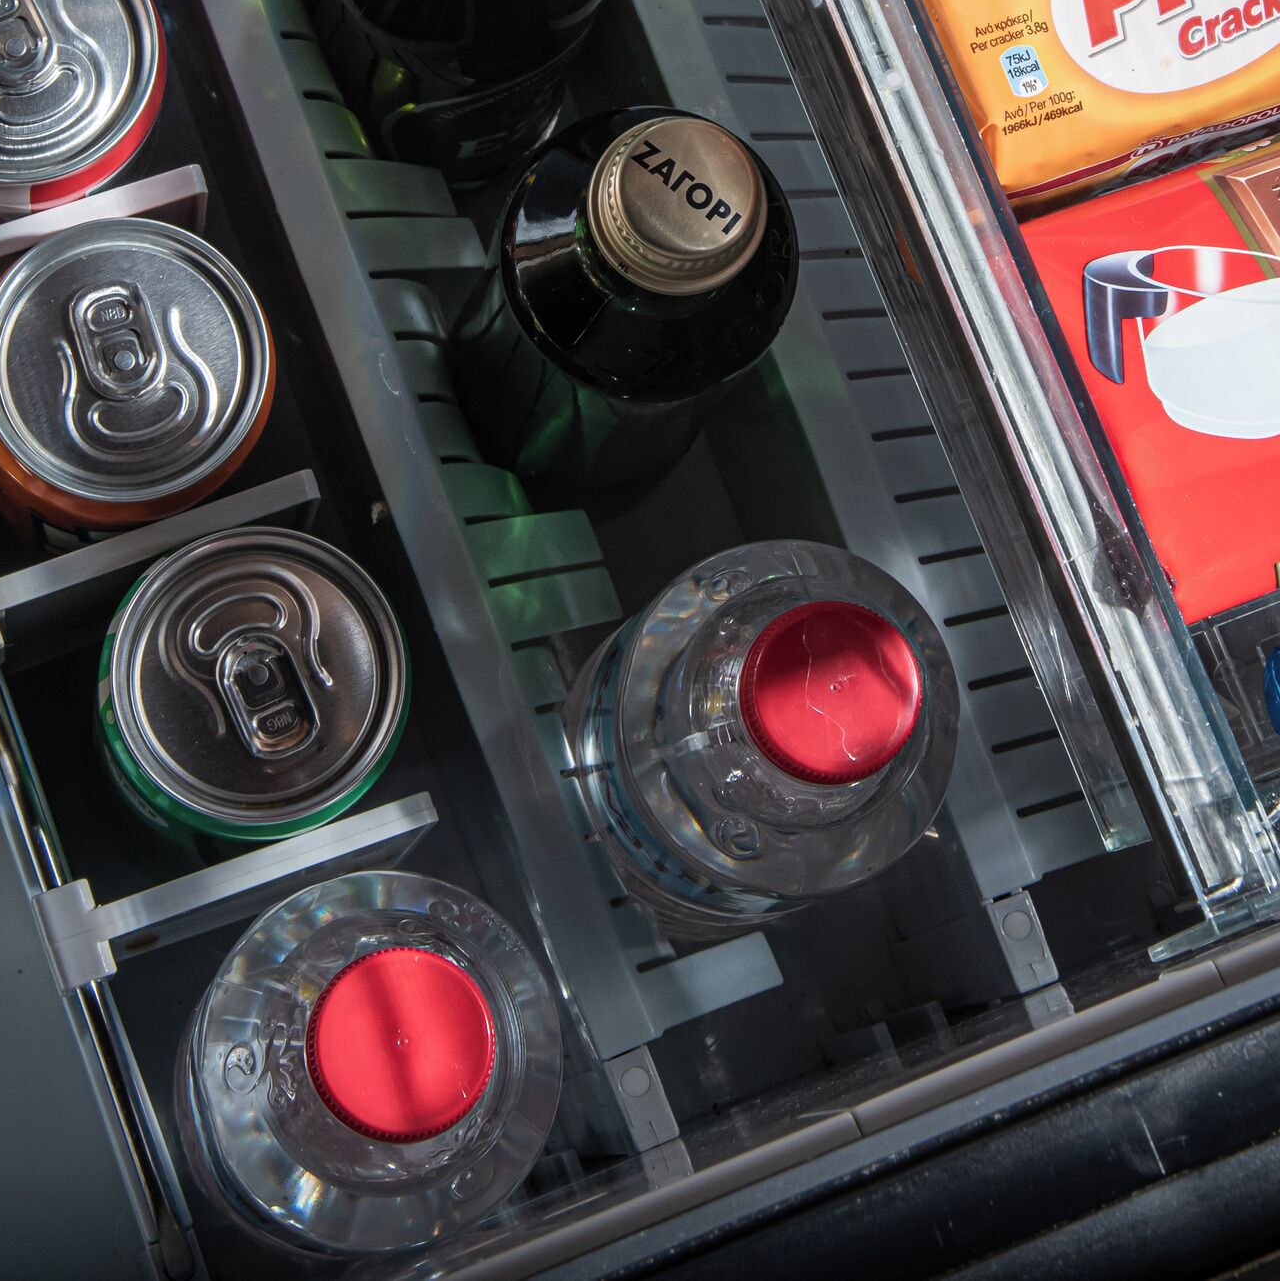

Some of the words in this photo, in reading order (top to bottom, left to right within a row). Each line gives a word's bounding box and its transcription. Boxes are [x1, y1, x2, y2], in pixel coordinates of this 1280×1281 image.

[969, 40, 988, 54] Per
[988, 27, 1025, 47] cracker
[1024, 19, 1049, 36] 3,8g
[973, 21, 993, 38] Ανά
[1005, 48, 1031, 66] 75kJ
[1006, 59, 1040, 79] 18kcal
[1047, 88, 1077, 107] 100g:
[627, 139, 744, 239] ΖΑΓΟΡΙ
